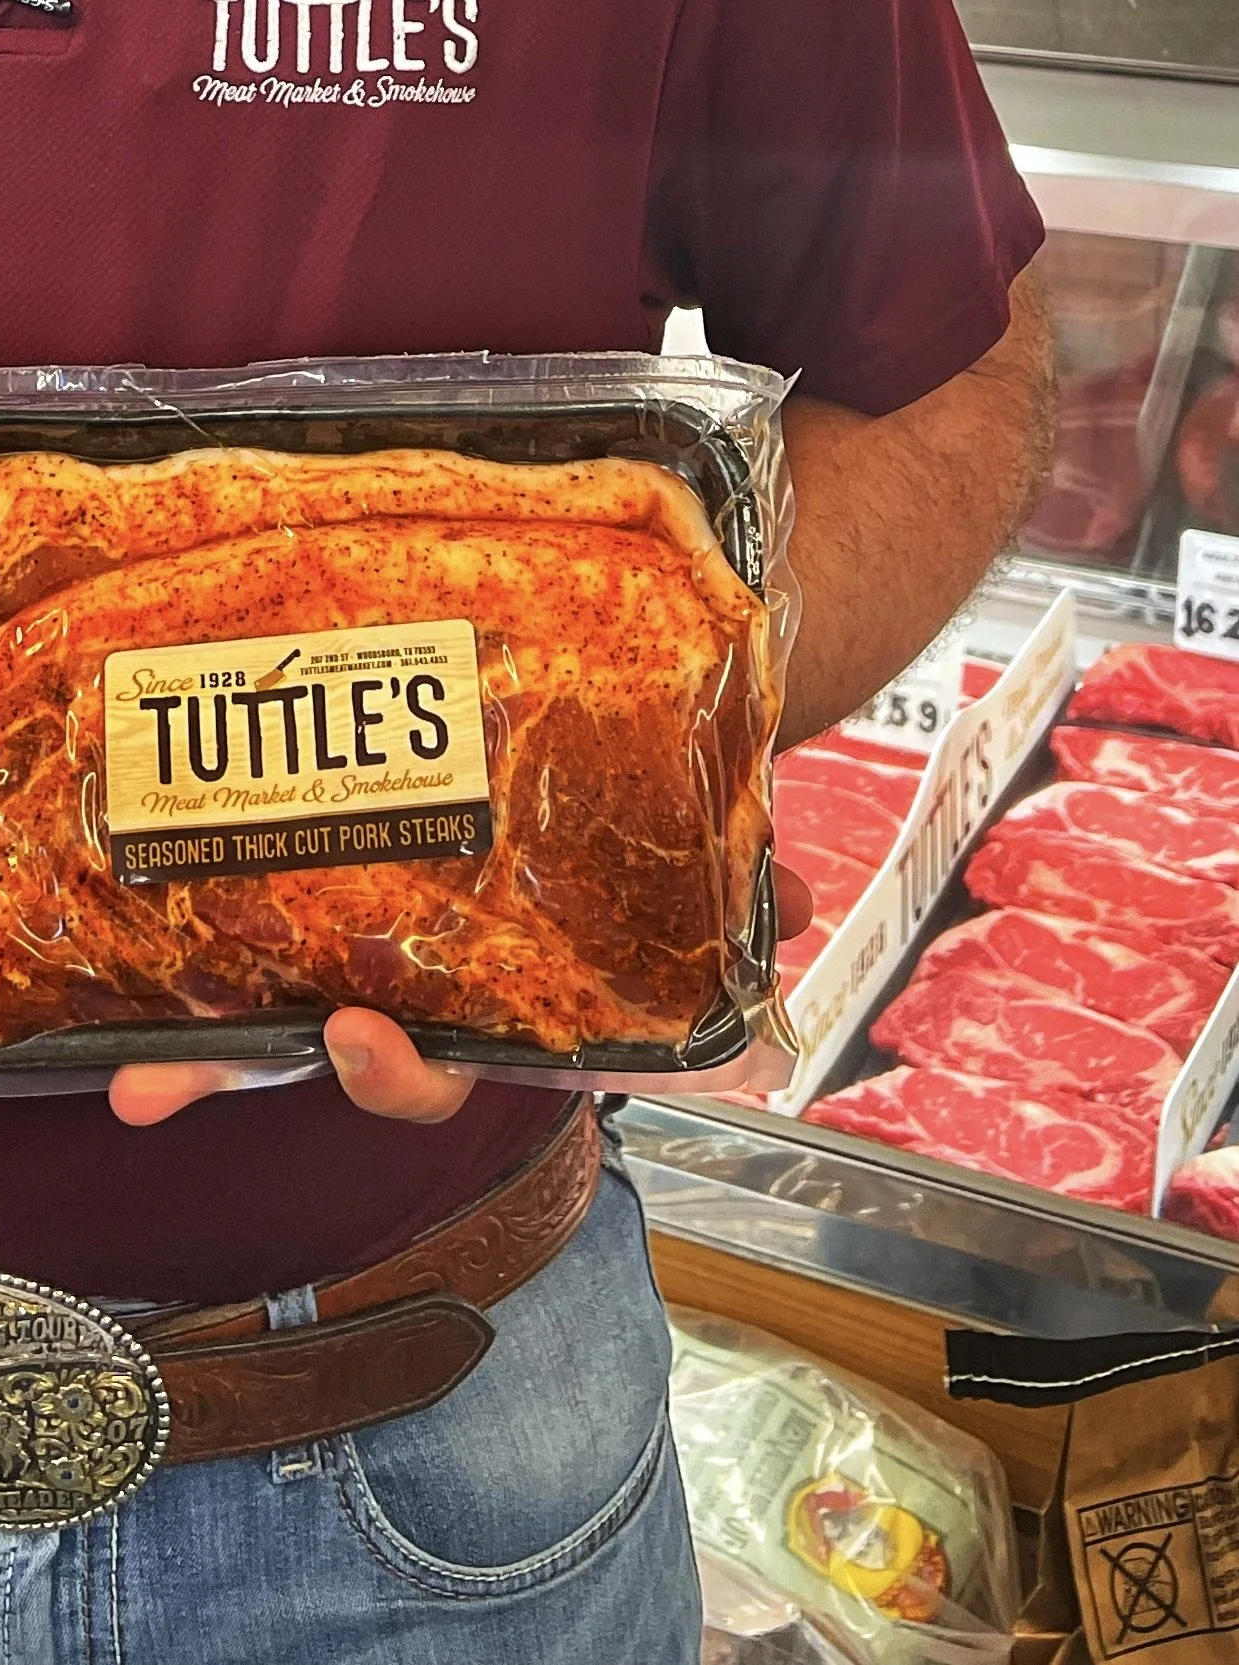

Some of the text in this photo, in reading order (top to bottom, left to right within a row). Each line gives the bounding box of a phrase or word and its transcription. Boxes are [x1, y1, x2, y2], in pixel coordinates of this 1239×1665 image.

[192, 75, 476, 108] Meat Market & Smokehouse
[115, 668, 246, 702] Since 1928
[139, 674, 449, 785] TUTTLE'S
[140, 770, 453, 818] Meat Market & Smokehouse
[125, 814, 476, 870] SEASONED THICK CUT PORK STEAKS
[1094, 1490, 1191, 1536] WARNING
